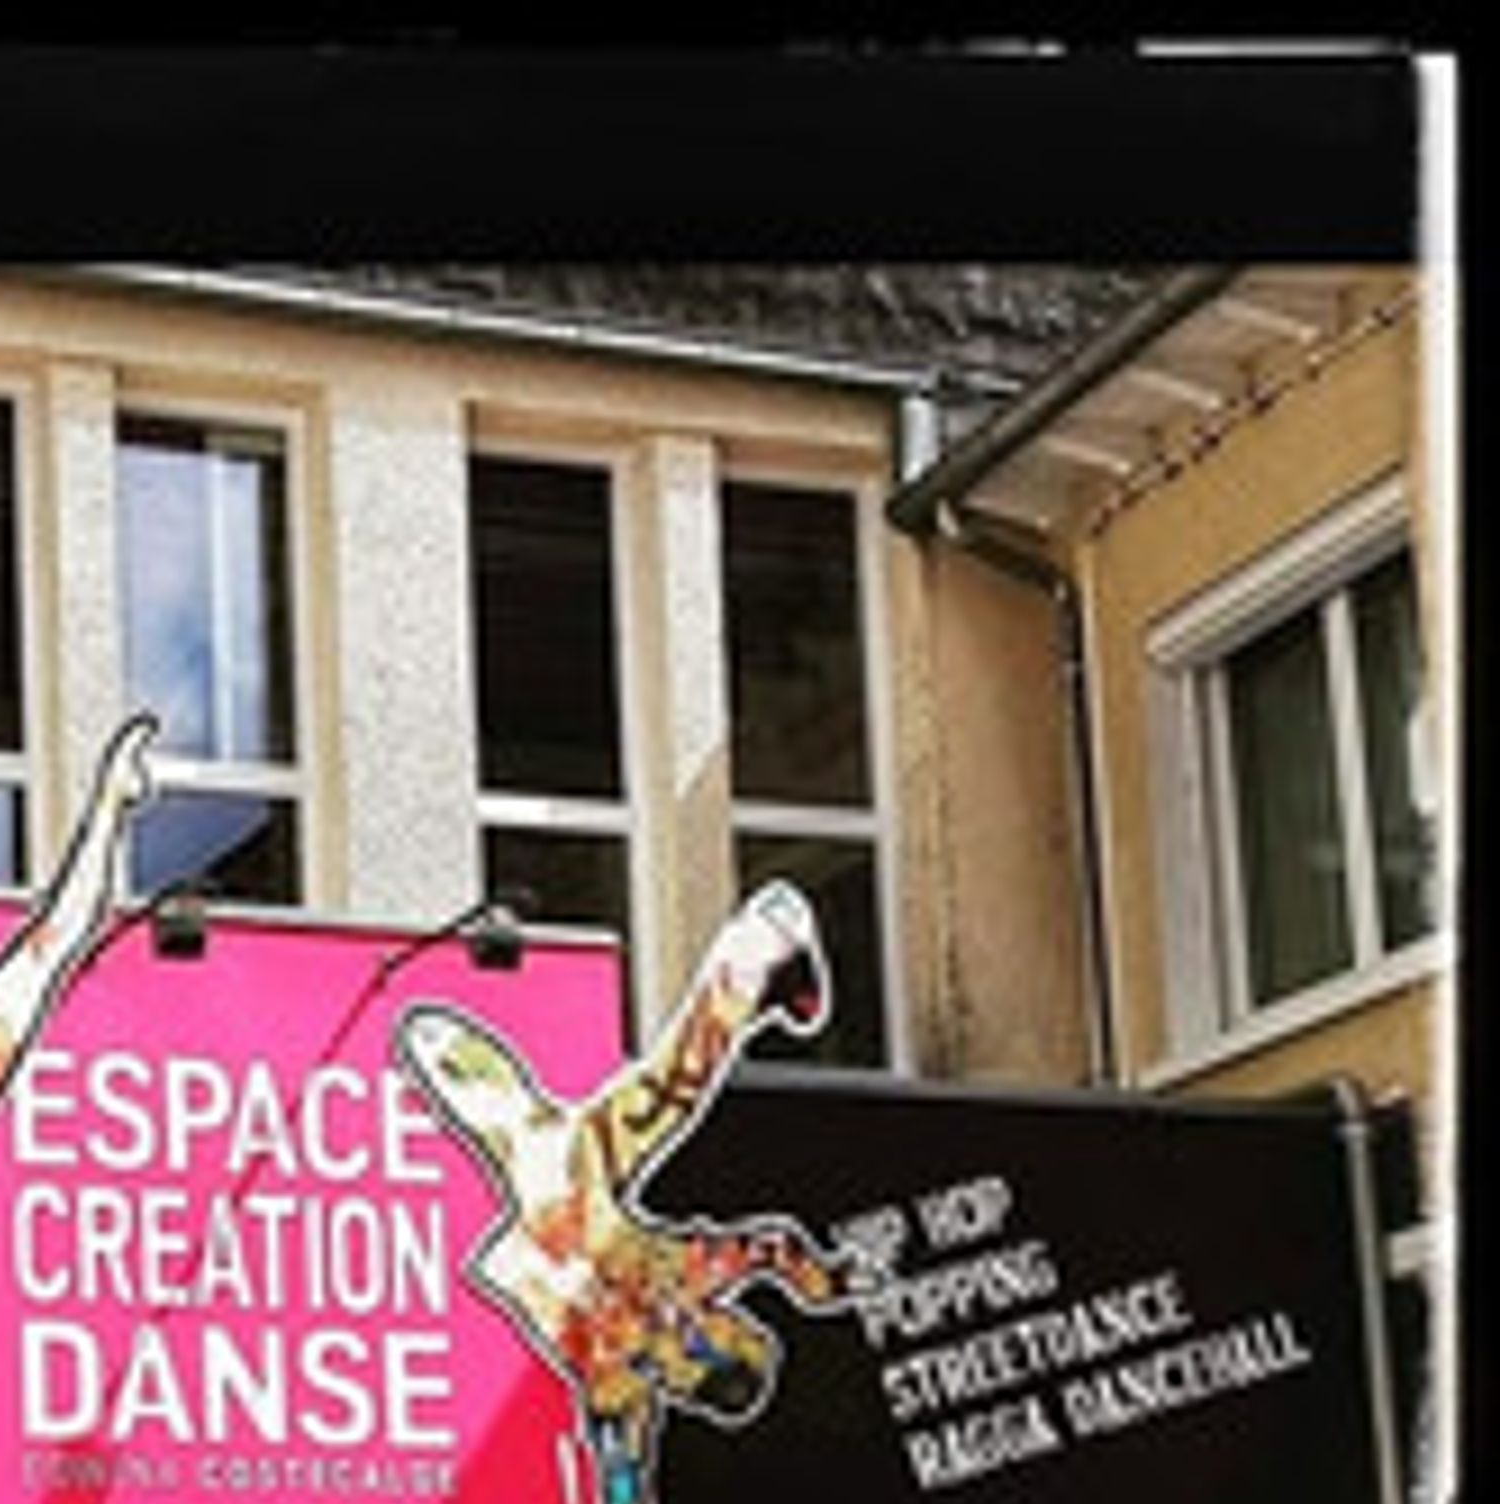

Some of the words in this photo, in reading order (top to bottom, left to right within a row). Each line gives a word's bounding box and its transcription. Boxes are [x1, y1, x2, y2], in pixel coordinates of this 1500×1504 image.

[13, 1050, 443, 1181] ESPACE
[13, 1186, 449, 1314] CREATION
[916, 1177, 1012, 1248] HOP
[855, 1242, 1057, 1349] POPPING
[883, 1272, 1192, 1417] STREETDANCE
[22, 1323, 456, 1447] DANSE
[907, 1398, 1060, 1489] RAGGA
[1063, 1313, 1311, 1435] DANCEHALL
